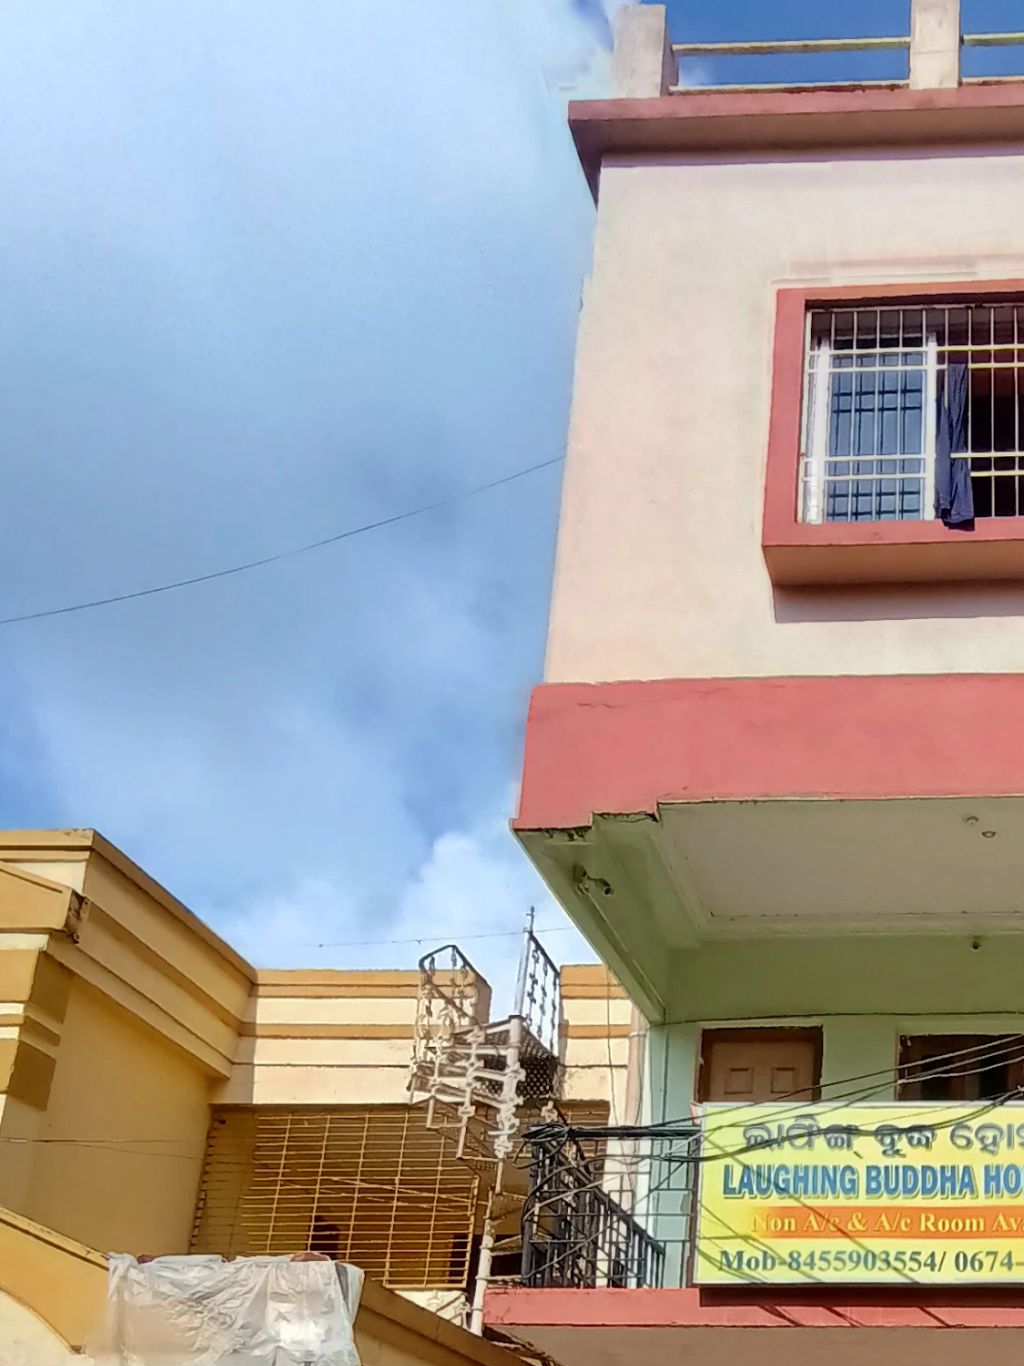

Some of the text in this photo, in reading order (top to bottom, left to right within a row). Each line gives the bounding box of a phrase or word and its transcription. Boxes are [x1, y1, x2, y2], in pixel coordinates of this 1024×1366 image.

[722, 1163, 860, 1200] LAUGHING
[865, 1163, 978, 1199] BUDDHA
[751, 1213, 796, 1233] Non
[803, 1213, 841, 1233] A/c
[848, 1212, 867, 1232] &
[874, 1212, 912, 1233] A/c
[919, 1212, 985, 1233] Room
